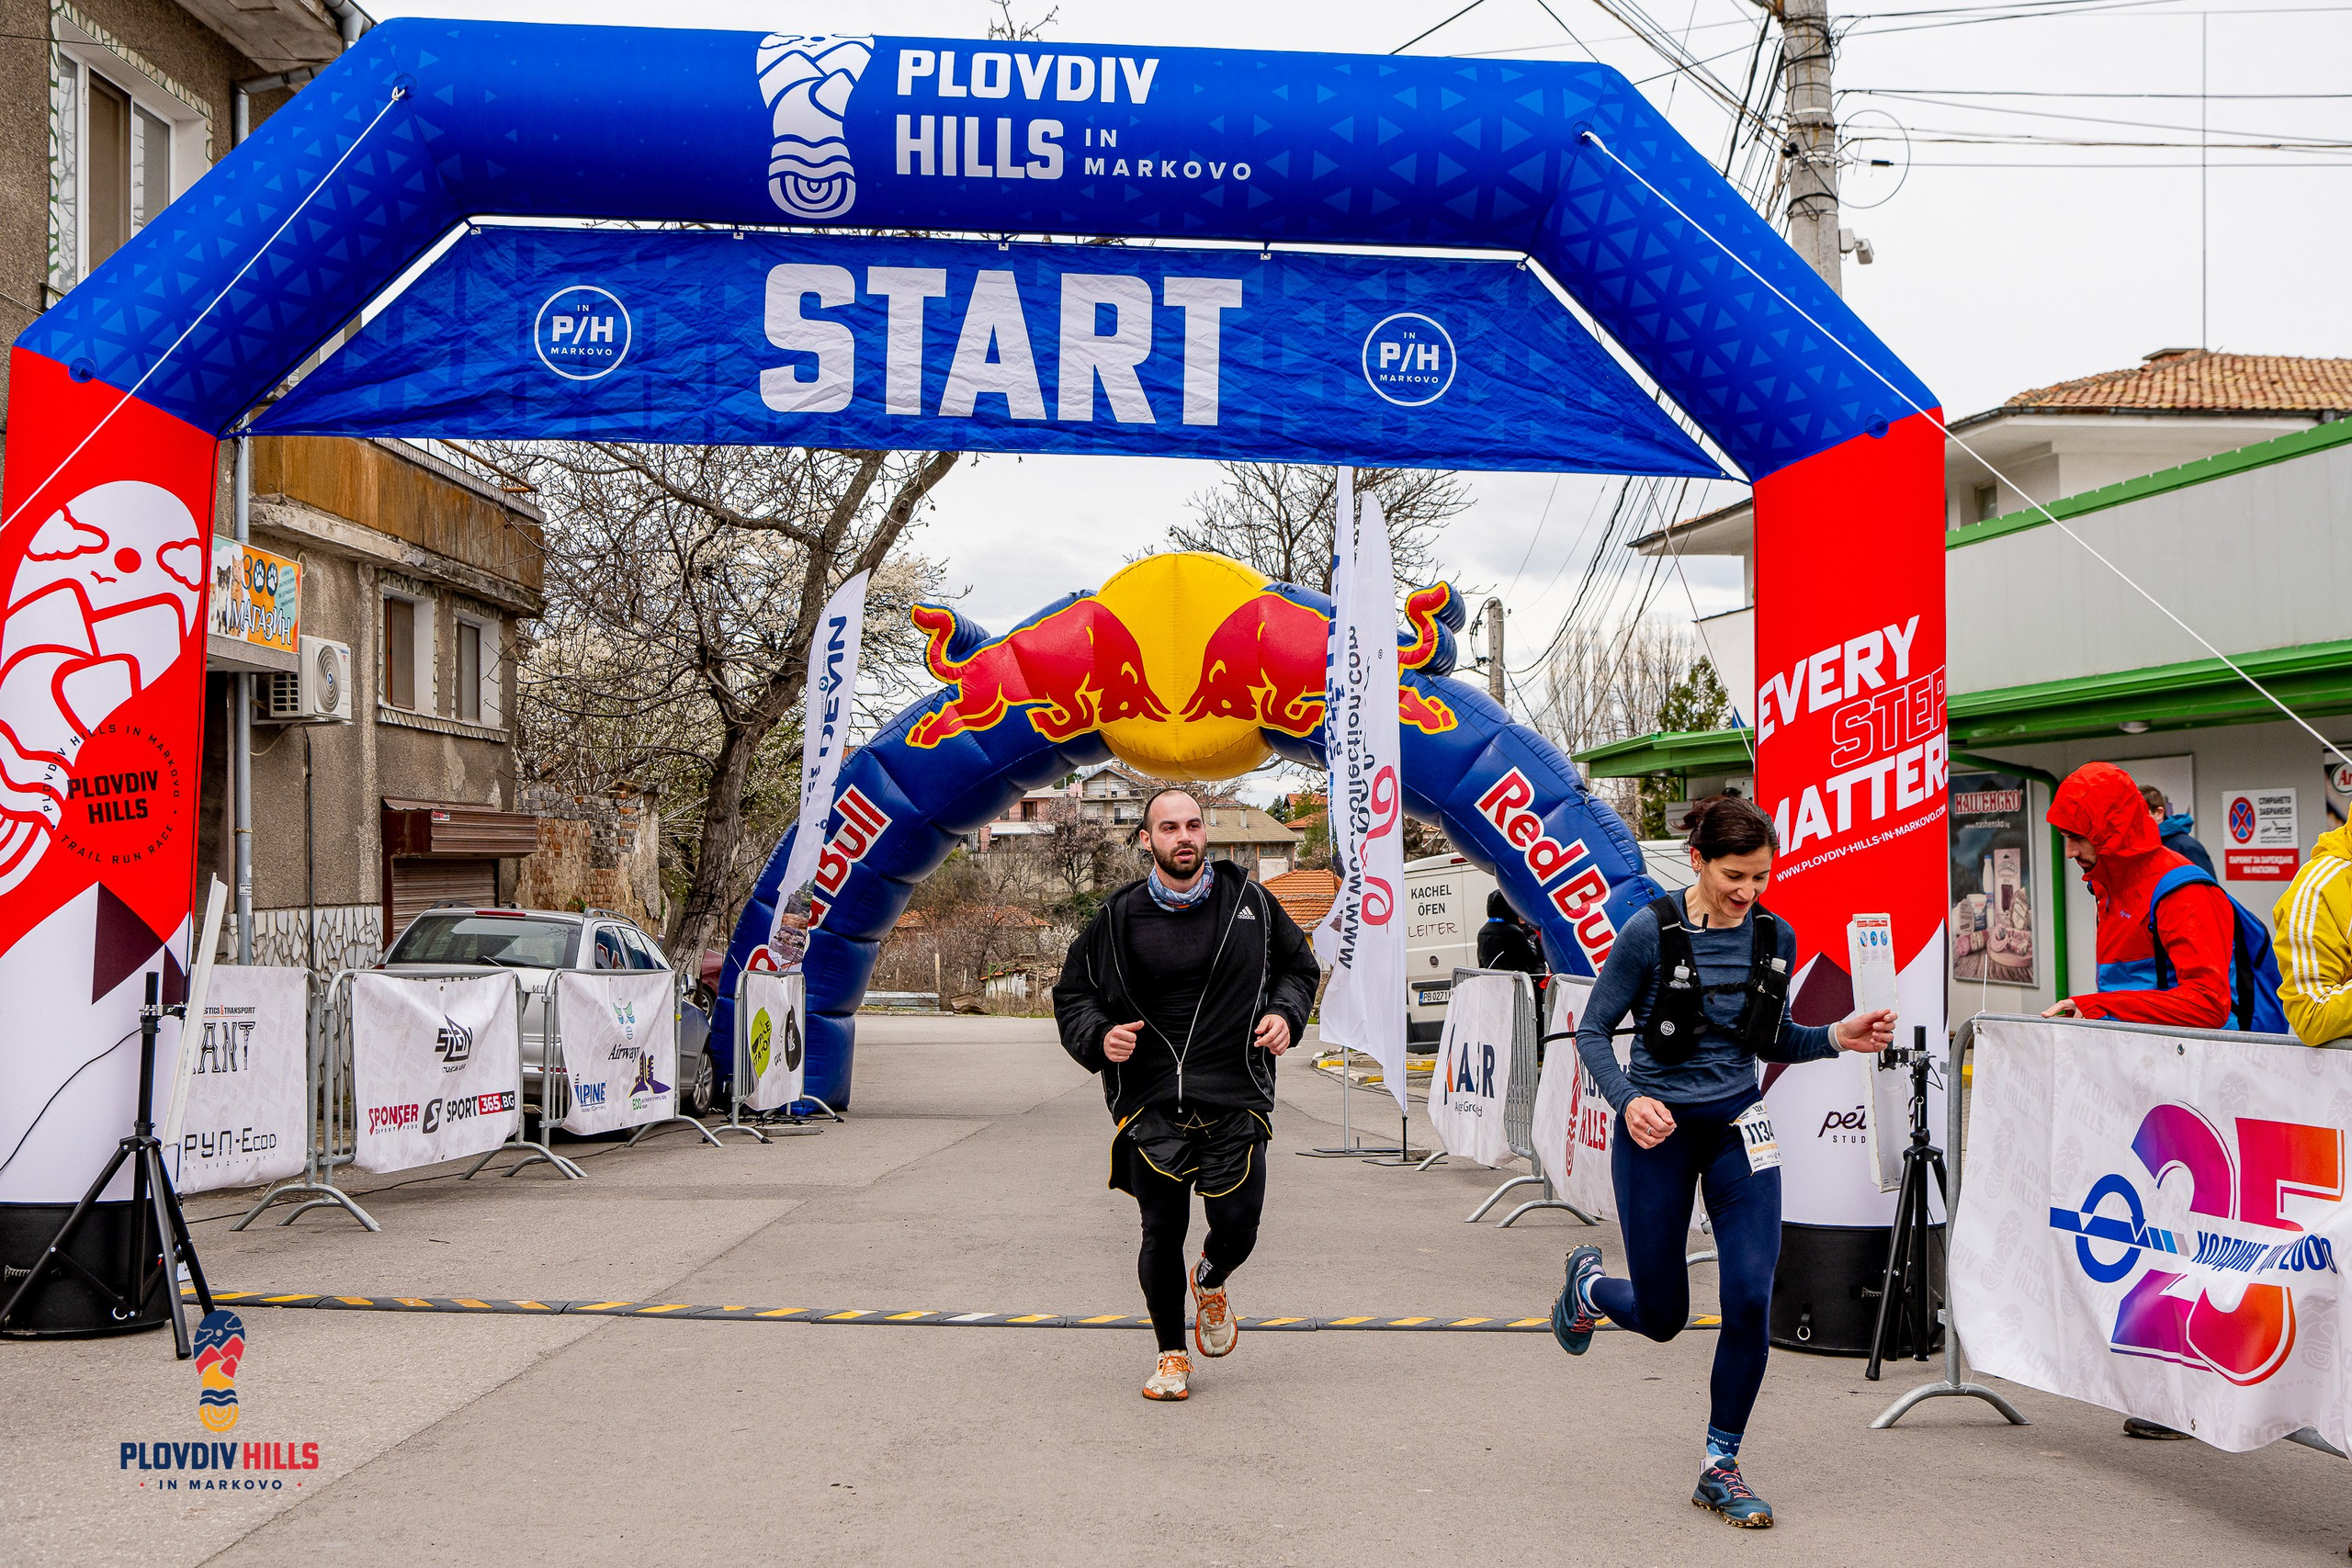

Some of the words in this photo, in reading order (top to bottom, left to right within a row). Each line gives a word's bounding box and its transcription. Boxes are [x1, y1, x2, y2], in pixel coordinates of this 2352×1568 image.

[896, 49, 1159, 105] PLOVDIV
[896, 114, 1064, 180] HILLS
[1085, 128, 1118, 148] IN
[1084, 157, 1251, 181] MARKOVO
[577, 304, 590, 312] IN
[551, 315, 614, 345] P/H
[760, 263, 1243, 426] START
[550, 347, 613, 356] MARKOVO
[1380, 342, 1440, 373] P/H
[1379, 374, 1439, 384] MARKOVO
[231, 598, 292, 645] МАГАЗИН
[819, 615, 847, 757] DEVIN
[1758, 615, 1920, 746] EVERY
[1831, 664, 1946, 768] STEP
[42, 747, 67, 812] PLOVDIV
[70, 724, 117, 746] HILLS
[126, 725, 141, 737] IN
[148, 734, 180, 797] MARKOVO
[67, 770, 159, 800] PLOVDIV
[87, 797, 149, 824] HILLS
[1954, 790, 2021, 814] НАШЕНСКО
[1478, 770, 1586, 883] Red
[61, 834, 101, 863] TRAIL
[112, 852, 141, 864] RUN
[148, 823, 174, 854] RACE
[1776, 804, 1946, 882] WWW.PLOVDIV-HILLS-IN-MARKOVO.COM
[1410, 885, 1452, 899] KACHEL
[1418, 902, 1446, 916] ÖFEN
[1408, 922, 1458, 938] LEITER
[224, 1006, 255, 1015] TRANSPORT
[368, 1103, 419, 1136] SPONSER
[2191, 1231, 2269, 1272] ХОЛДИНГ
